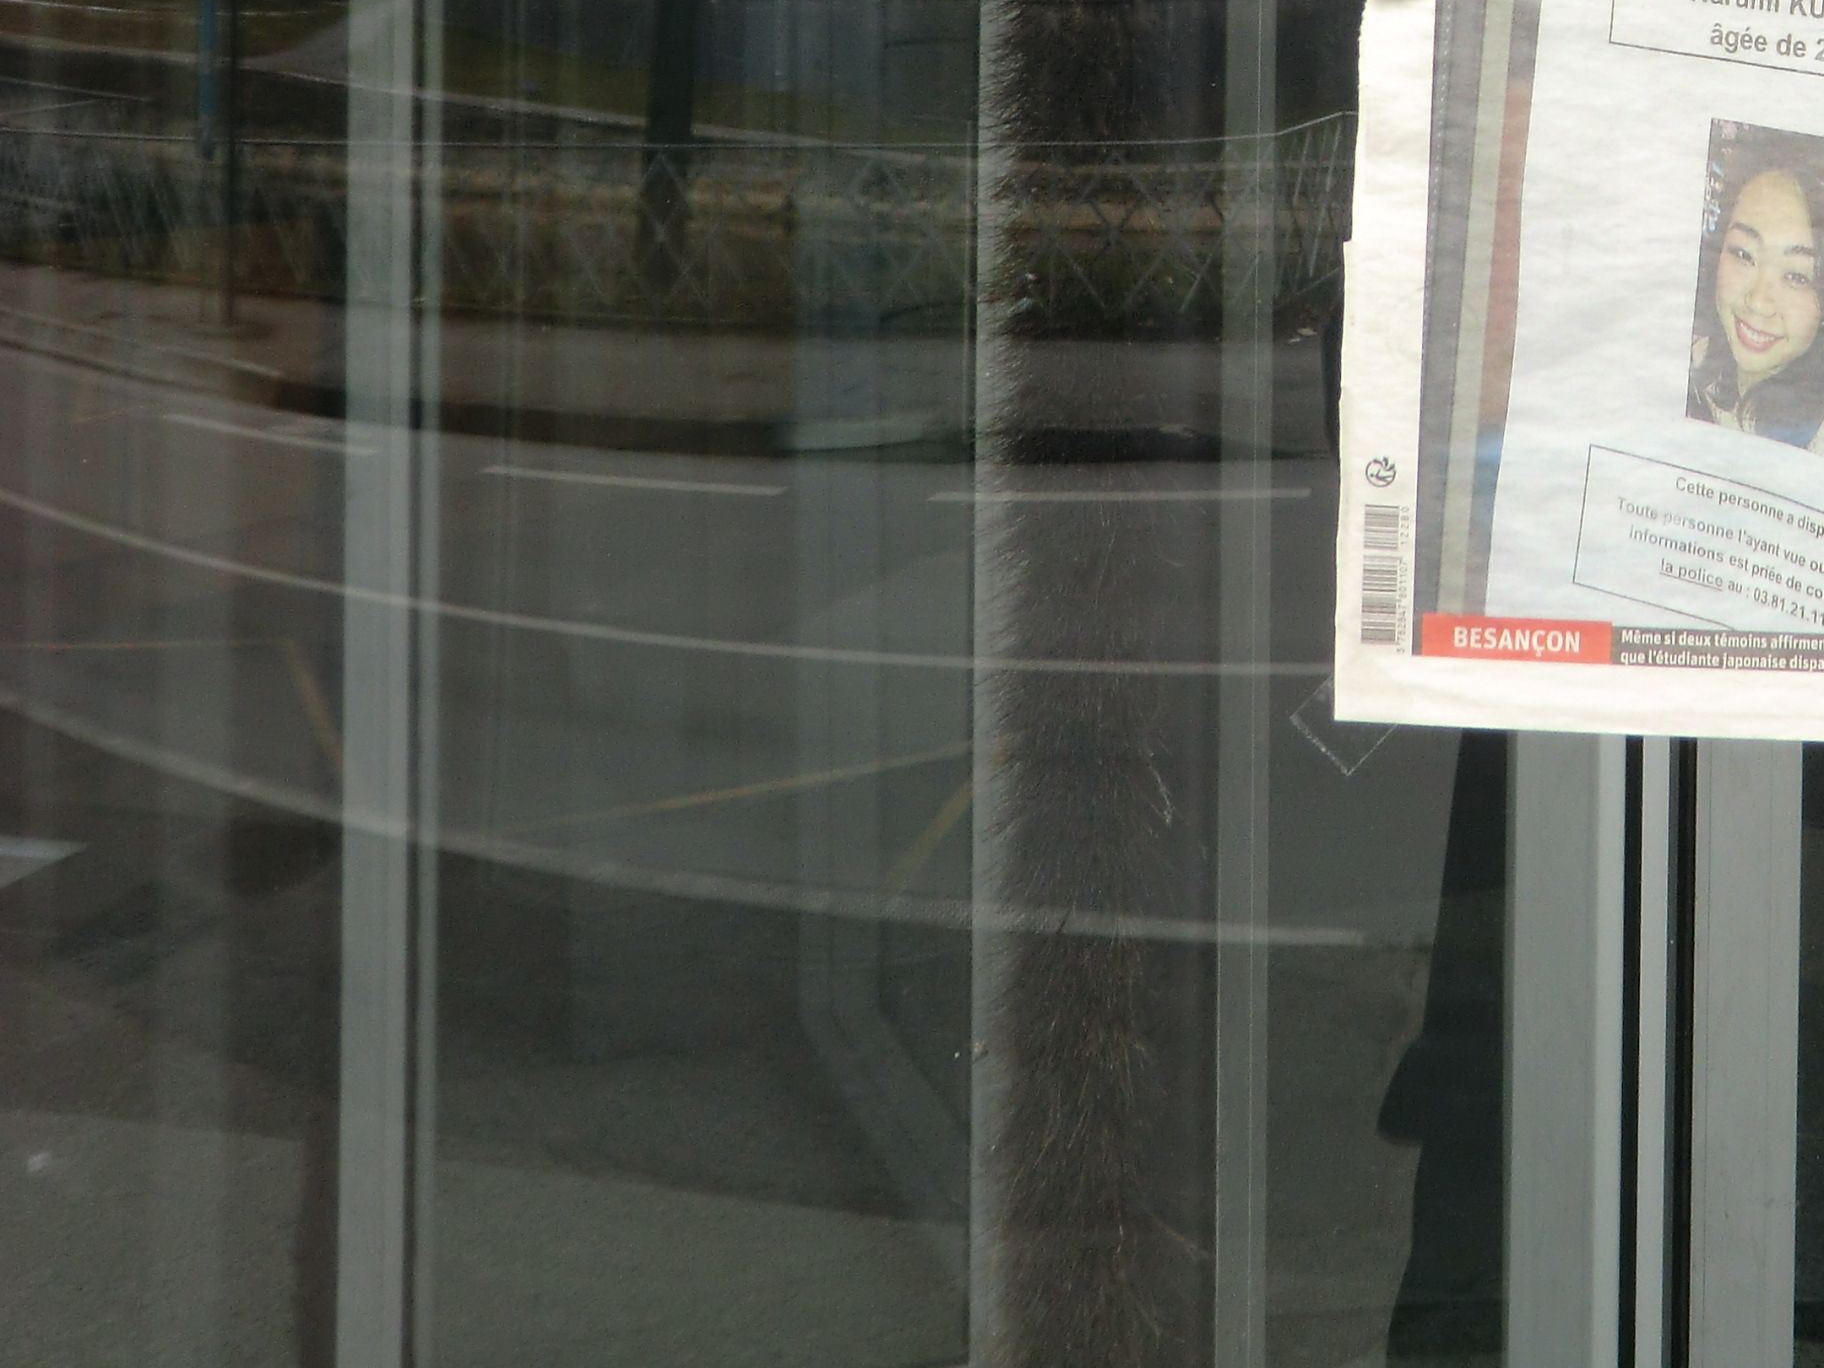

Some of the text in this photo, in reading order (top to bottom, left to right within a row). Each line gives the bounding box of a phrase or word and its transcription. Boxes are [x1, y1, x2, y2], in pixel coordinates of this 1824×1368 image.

[1710, 23, 1768, 54] âgée
[1776, 33, 1807, 58] de
[1675, 476, 1715, 499] Cette
[1718, 490, 1784, 521] personne
[1786, 514, 1795, 525] a
[1617, 496, 1658, 520] Toute
[1663, 511, 1735, 540] personne
[1738, 528, 1782, 557] l'ayant
[1783, 549, 1807, 567] vue
[1629, 524, 1725, 562] informations
[1729, 554, 1749, 572] est
[1751, 561, 1783, 585] priée
[1786, 575, 1802, 593] de
[1661, 557, 1673, 574] la
[1677, 563, 1724, 588] police
[1727, 580, 1743, 594] au
[1453, 626, 1580, 658] BESANÇON
[1621, 629, 1661, 645] Même
[1664, 632, 1675, 646] si
[1679, 631, 1711, 647] deux
[1715, 633, 1767, 649] témoins
[1621, 650, 1645, 665] que
[1649, 650, 1720, 666] l'étudiante
[1723, 653, 1787, 670] japonaise
